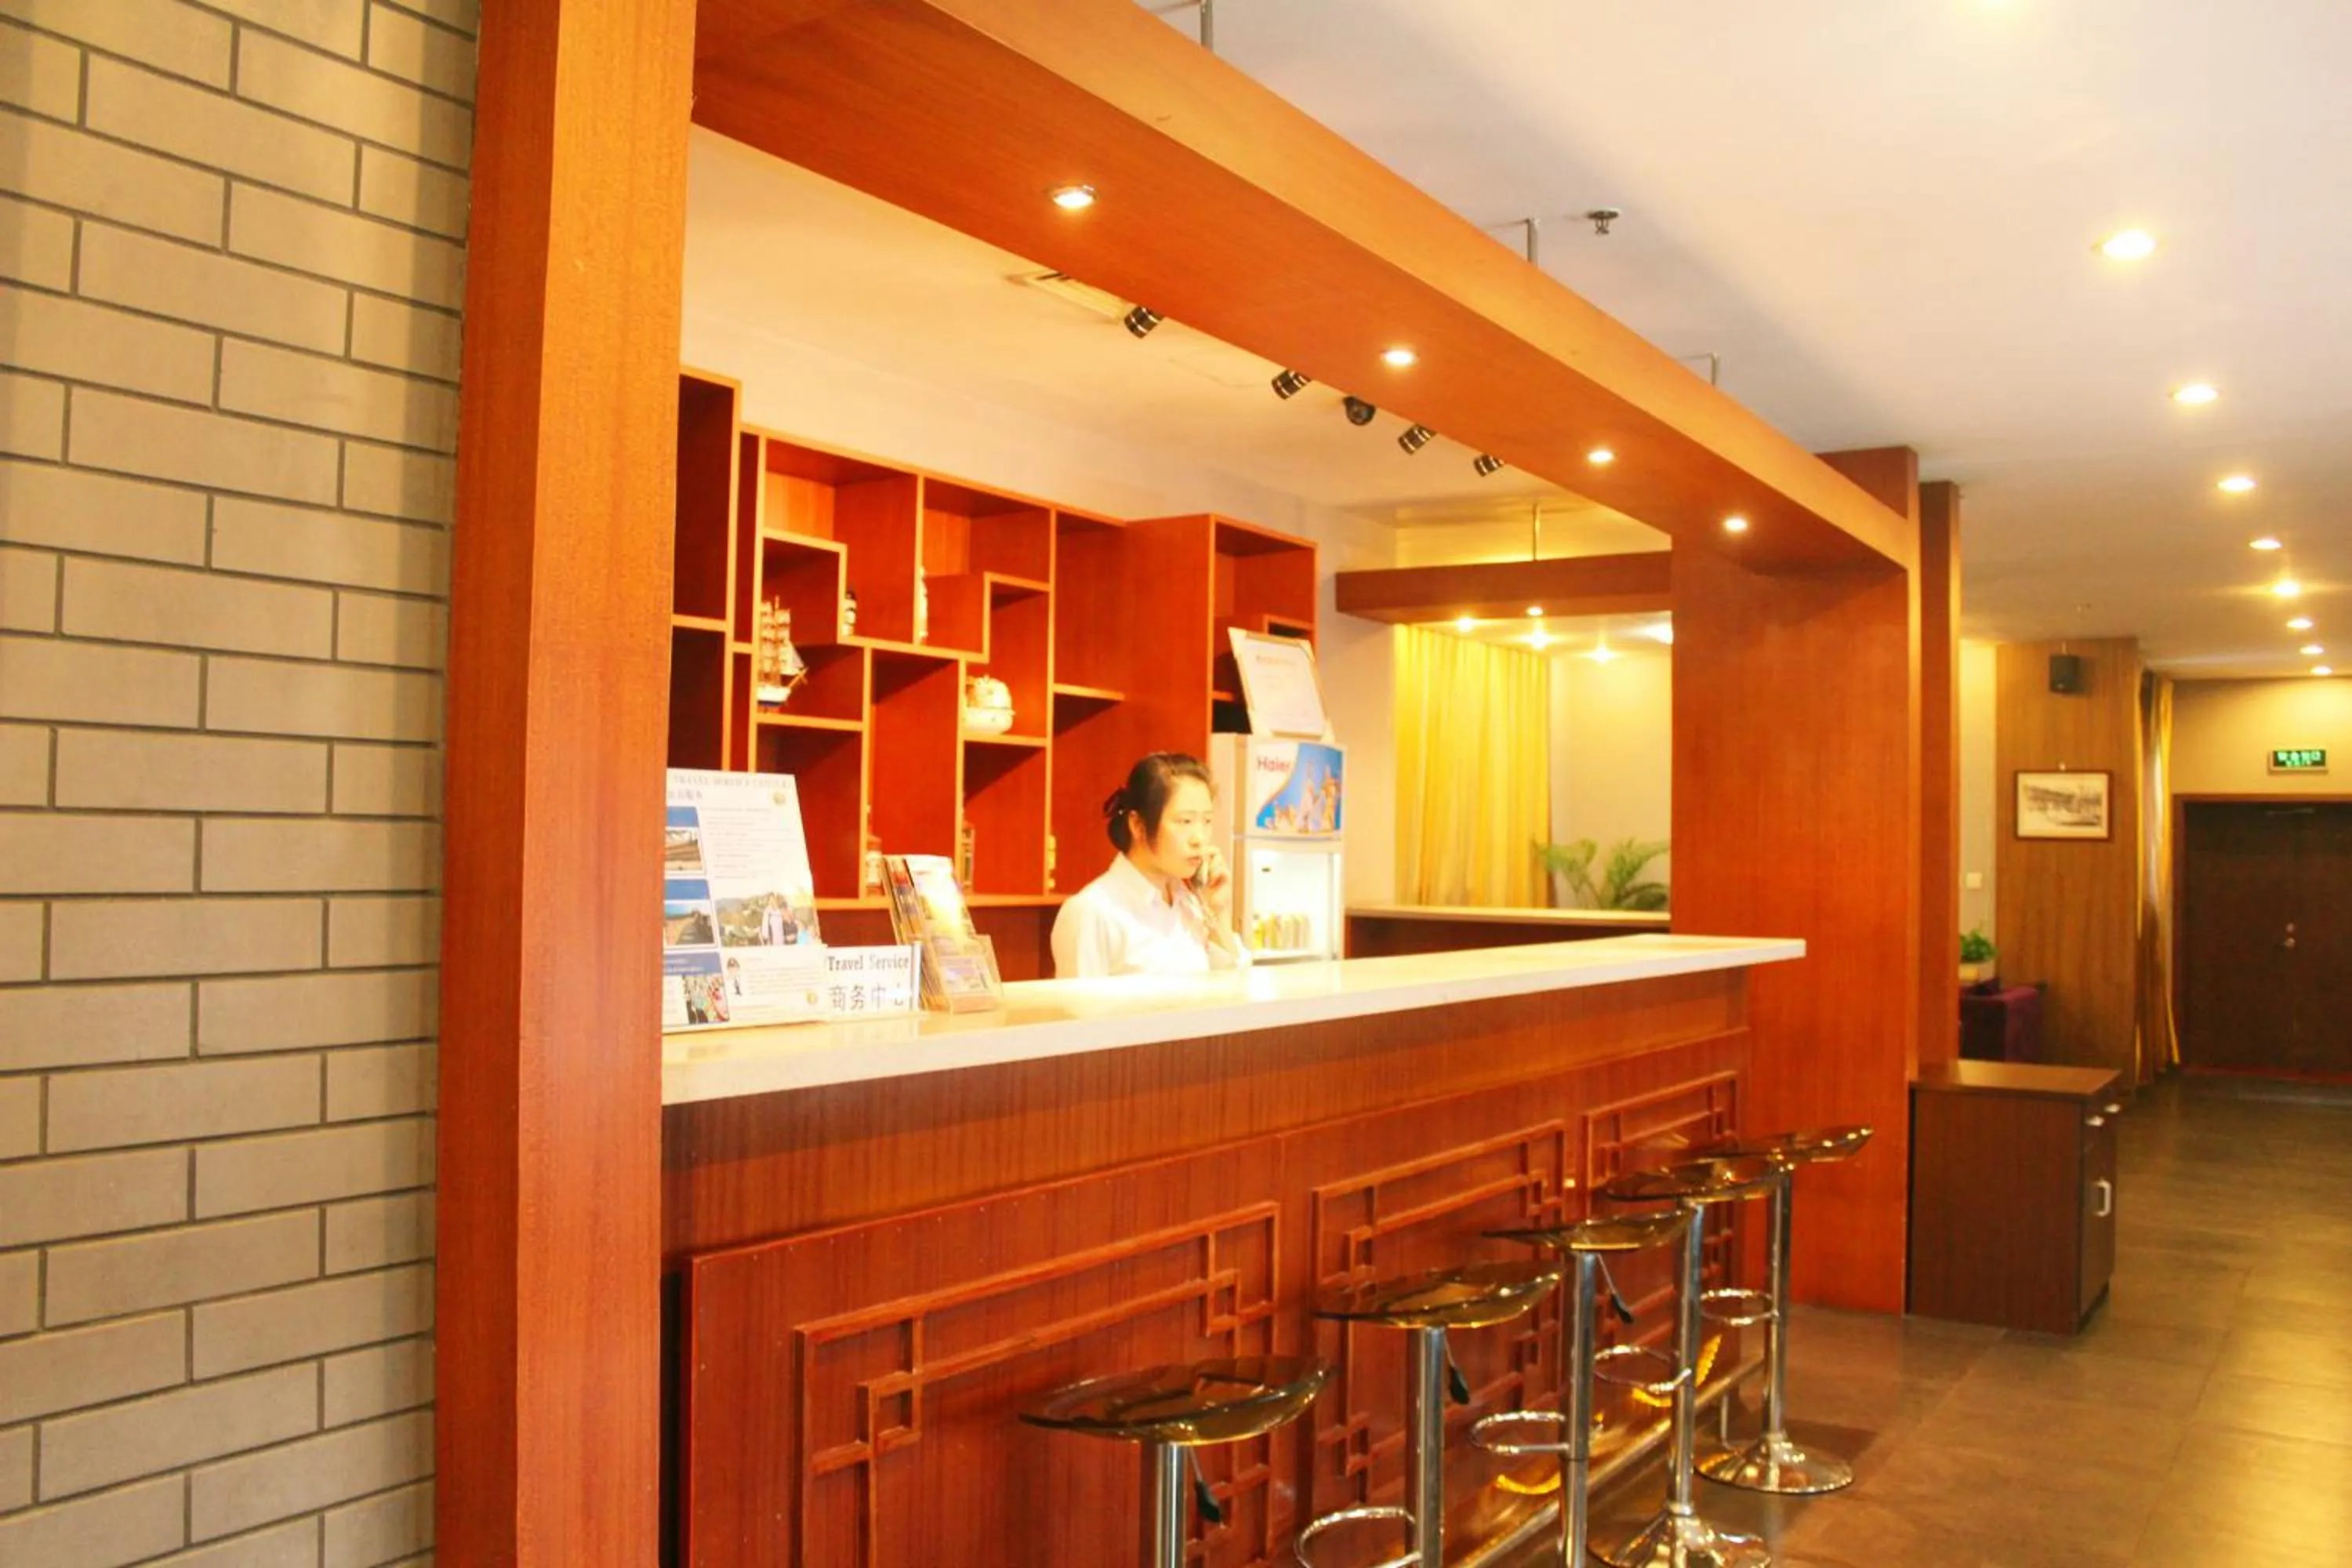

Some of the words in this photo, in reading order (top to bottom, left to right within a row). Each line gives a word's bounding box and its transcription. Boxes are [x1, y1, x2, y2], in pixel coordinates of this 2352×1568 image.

[1257, 755, 1290, 772] Haier
[828, 955, 864, 971] Travel
[869, 953, 909, 970] Service
[828, 982, 905, 1011] 商务中心
